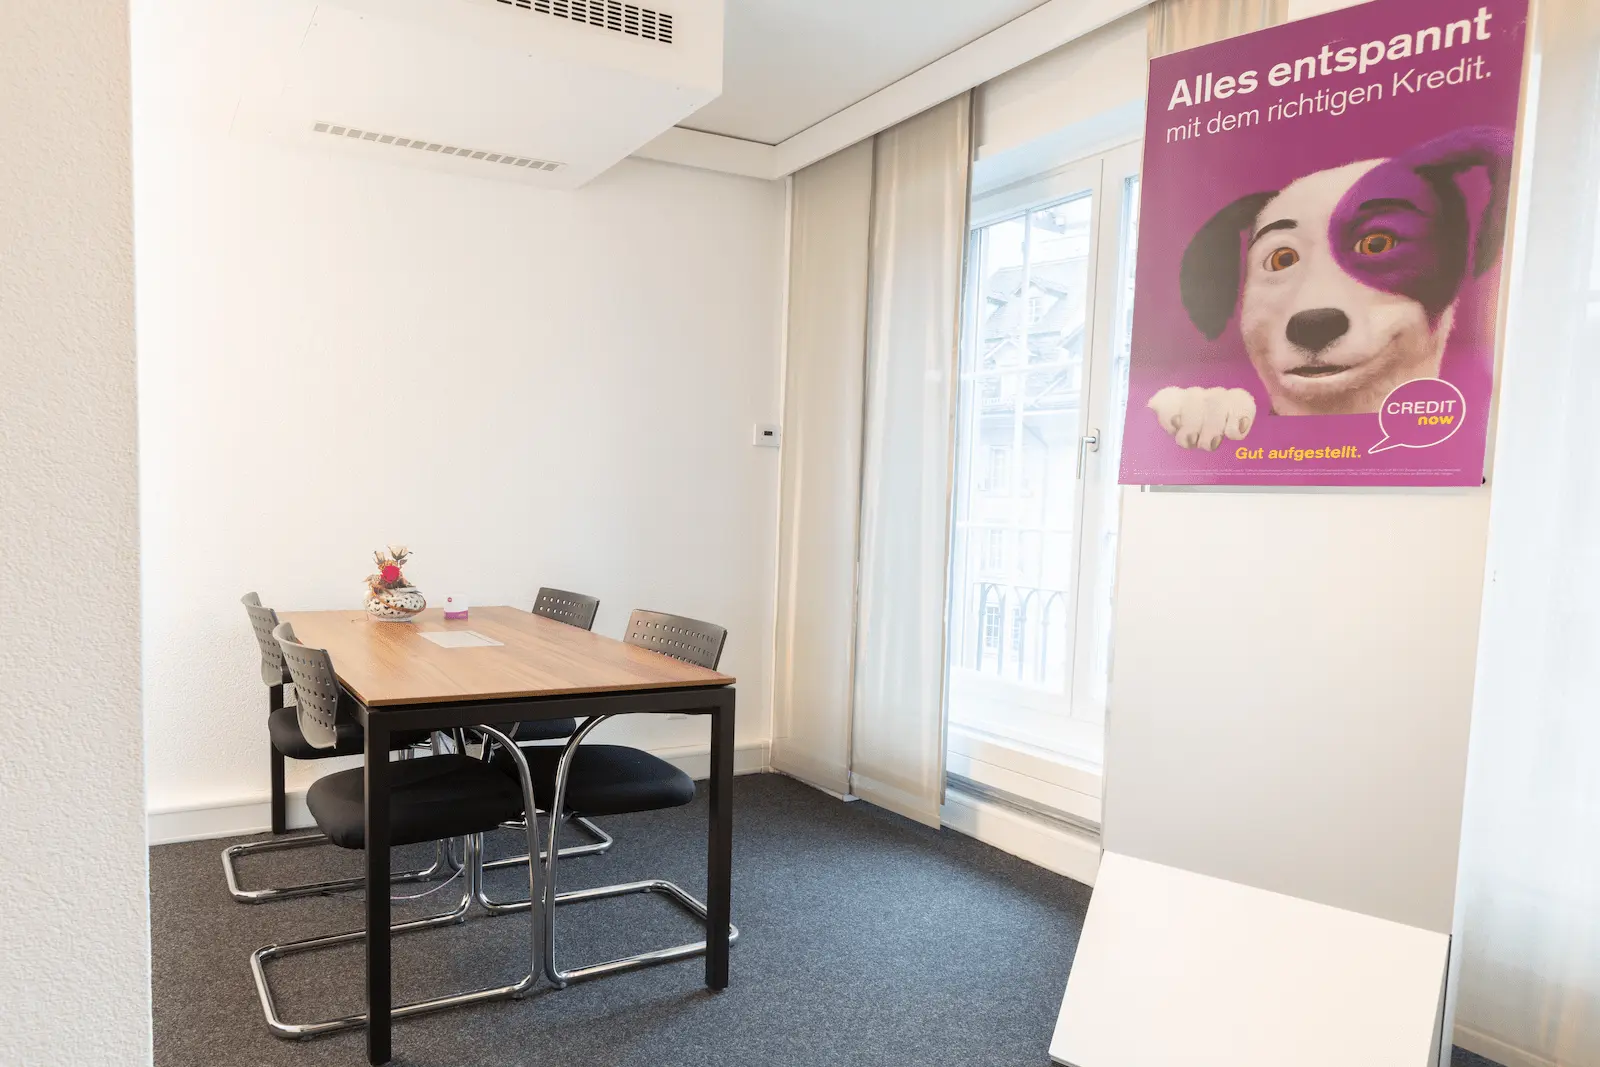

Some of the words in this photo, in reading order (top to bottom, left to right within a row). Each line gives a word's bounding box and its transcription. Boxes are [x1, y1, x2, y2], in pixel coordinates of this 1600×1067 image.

[1167, 70, 1259, 111] Alles
[1267, 6, 1493, 88] entspannt
[1166, 116, 1201, 143] mit
[1206, 107, 1260, 135] dem
[1267, 79, 1384, 123] richtigen
[1392, 55, 1492, 97] Kredit.
[1387, 400, 1456, 414] CREDIT
[1417, 415, 1454, 426] now
[1235, 447, 1264, 460] Gut
[1268, 445, 1362, 461] aufgestellt.
